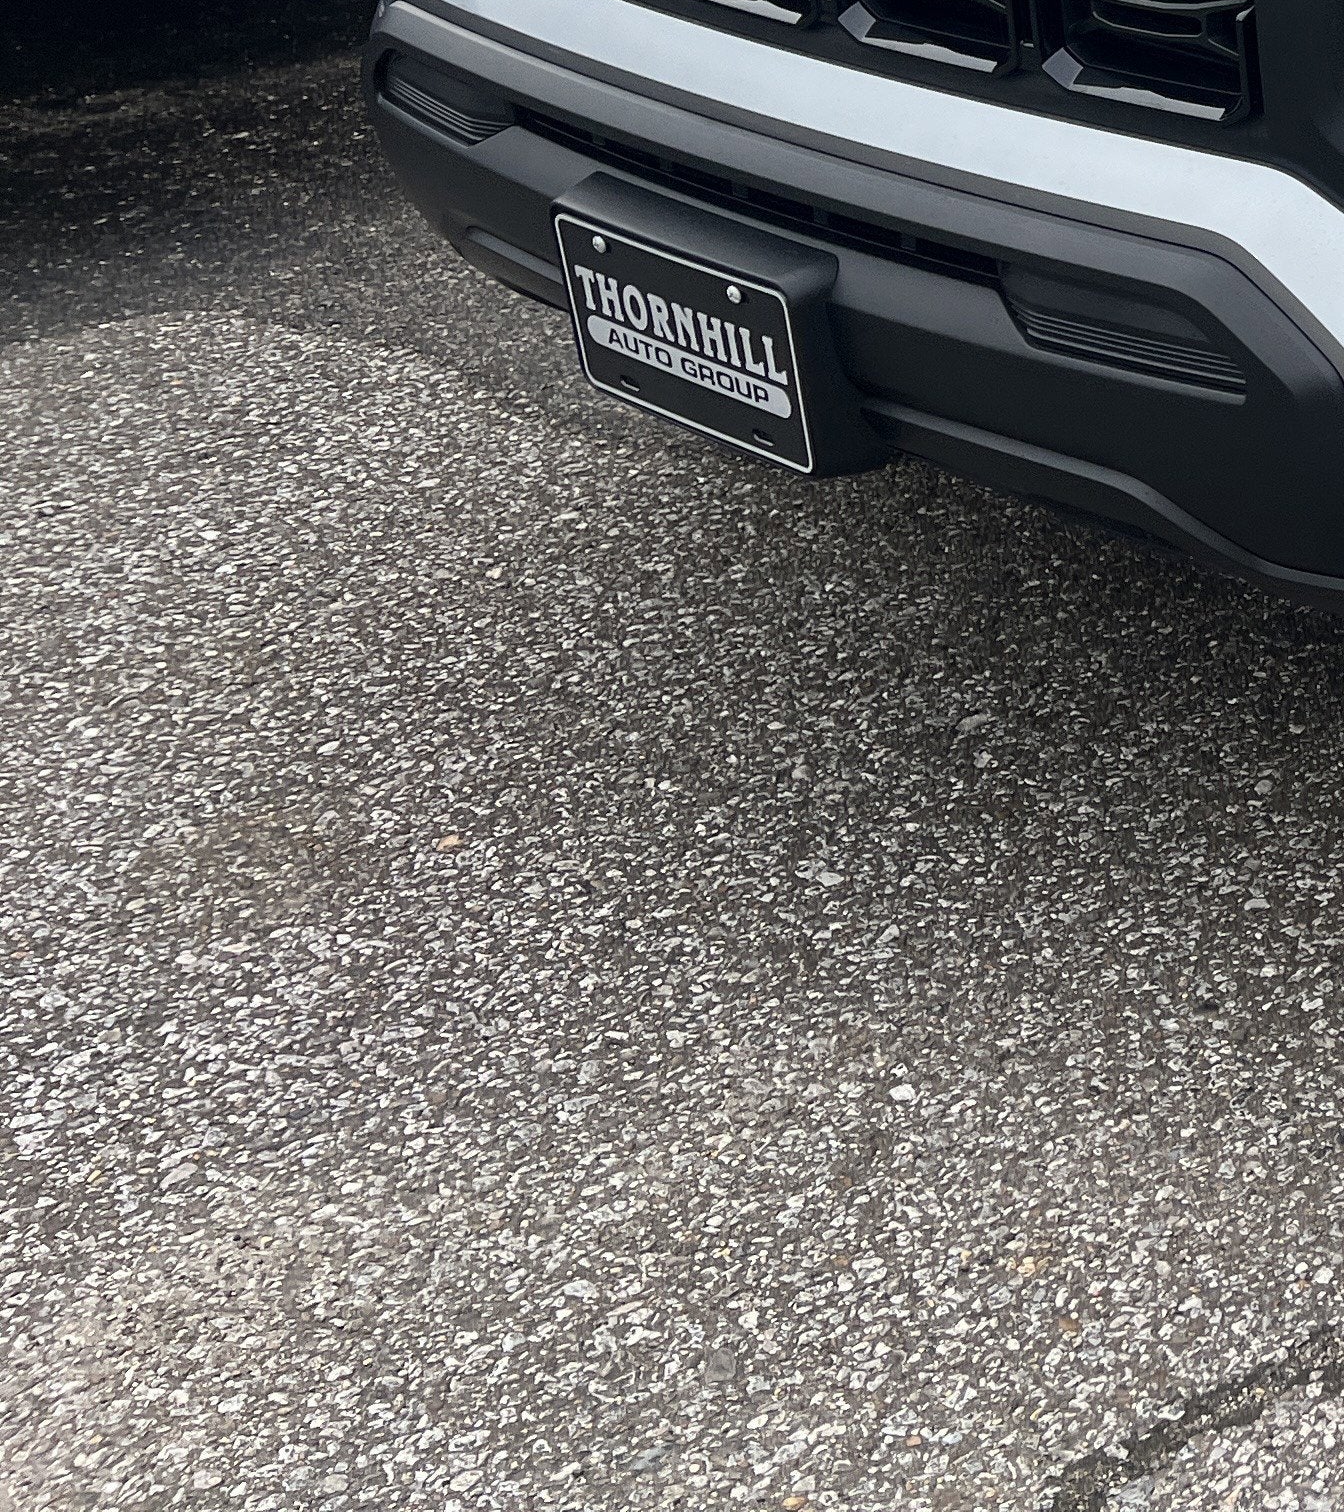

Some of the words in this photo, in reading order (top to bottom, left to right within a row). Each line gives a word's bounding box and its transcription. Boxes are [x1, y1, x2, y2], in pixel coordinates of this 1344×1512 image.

[575, 264, 789, 386] THORNHILL
[608, 328, 673, 368] AUTO
[681, 360, 770, 403] GROUP
